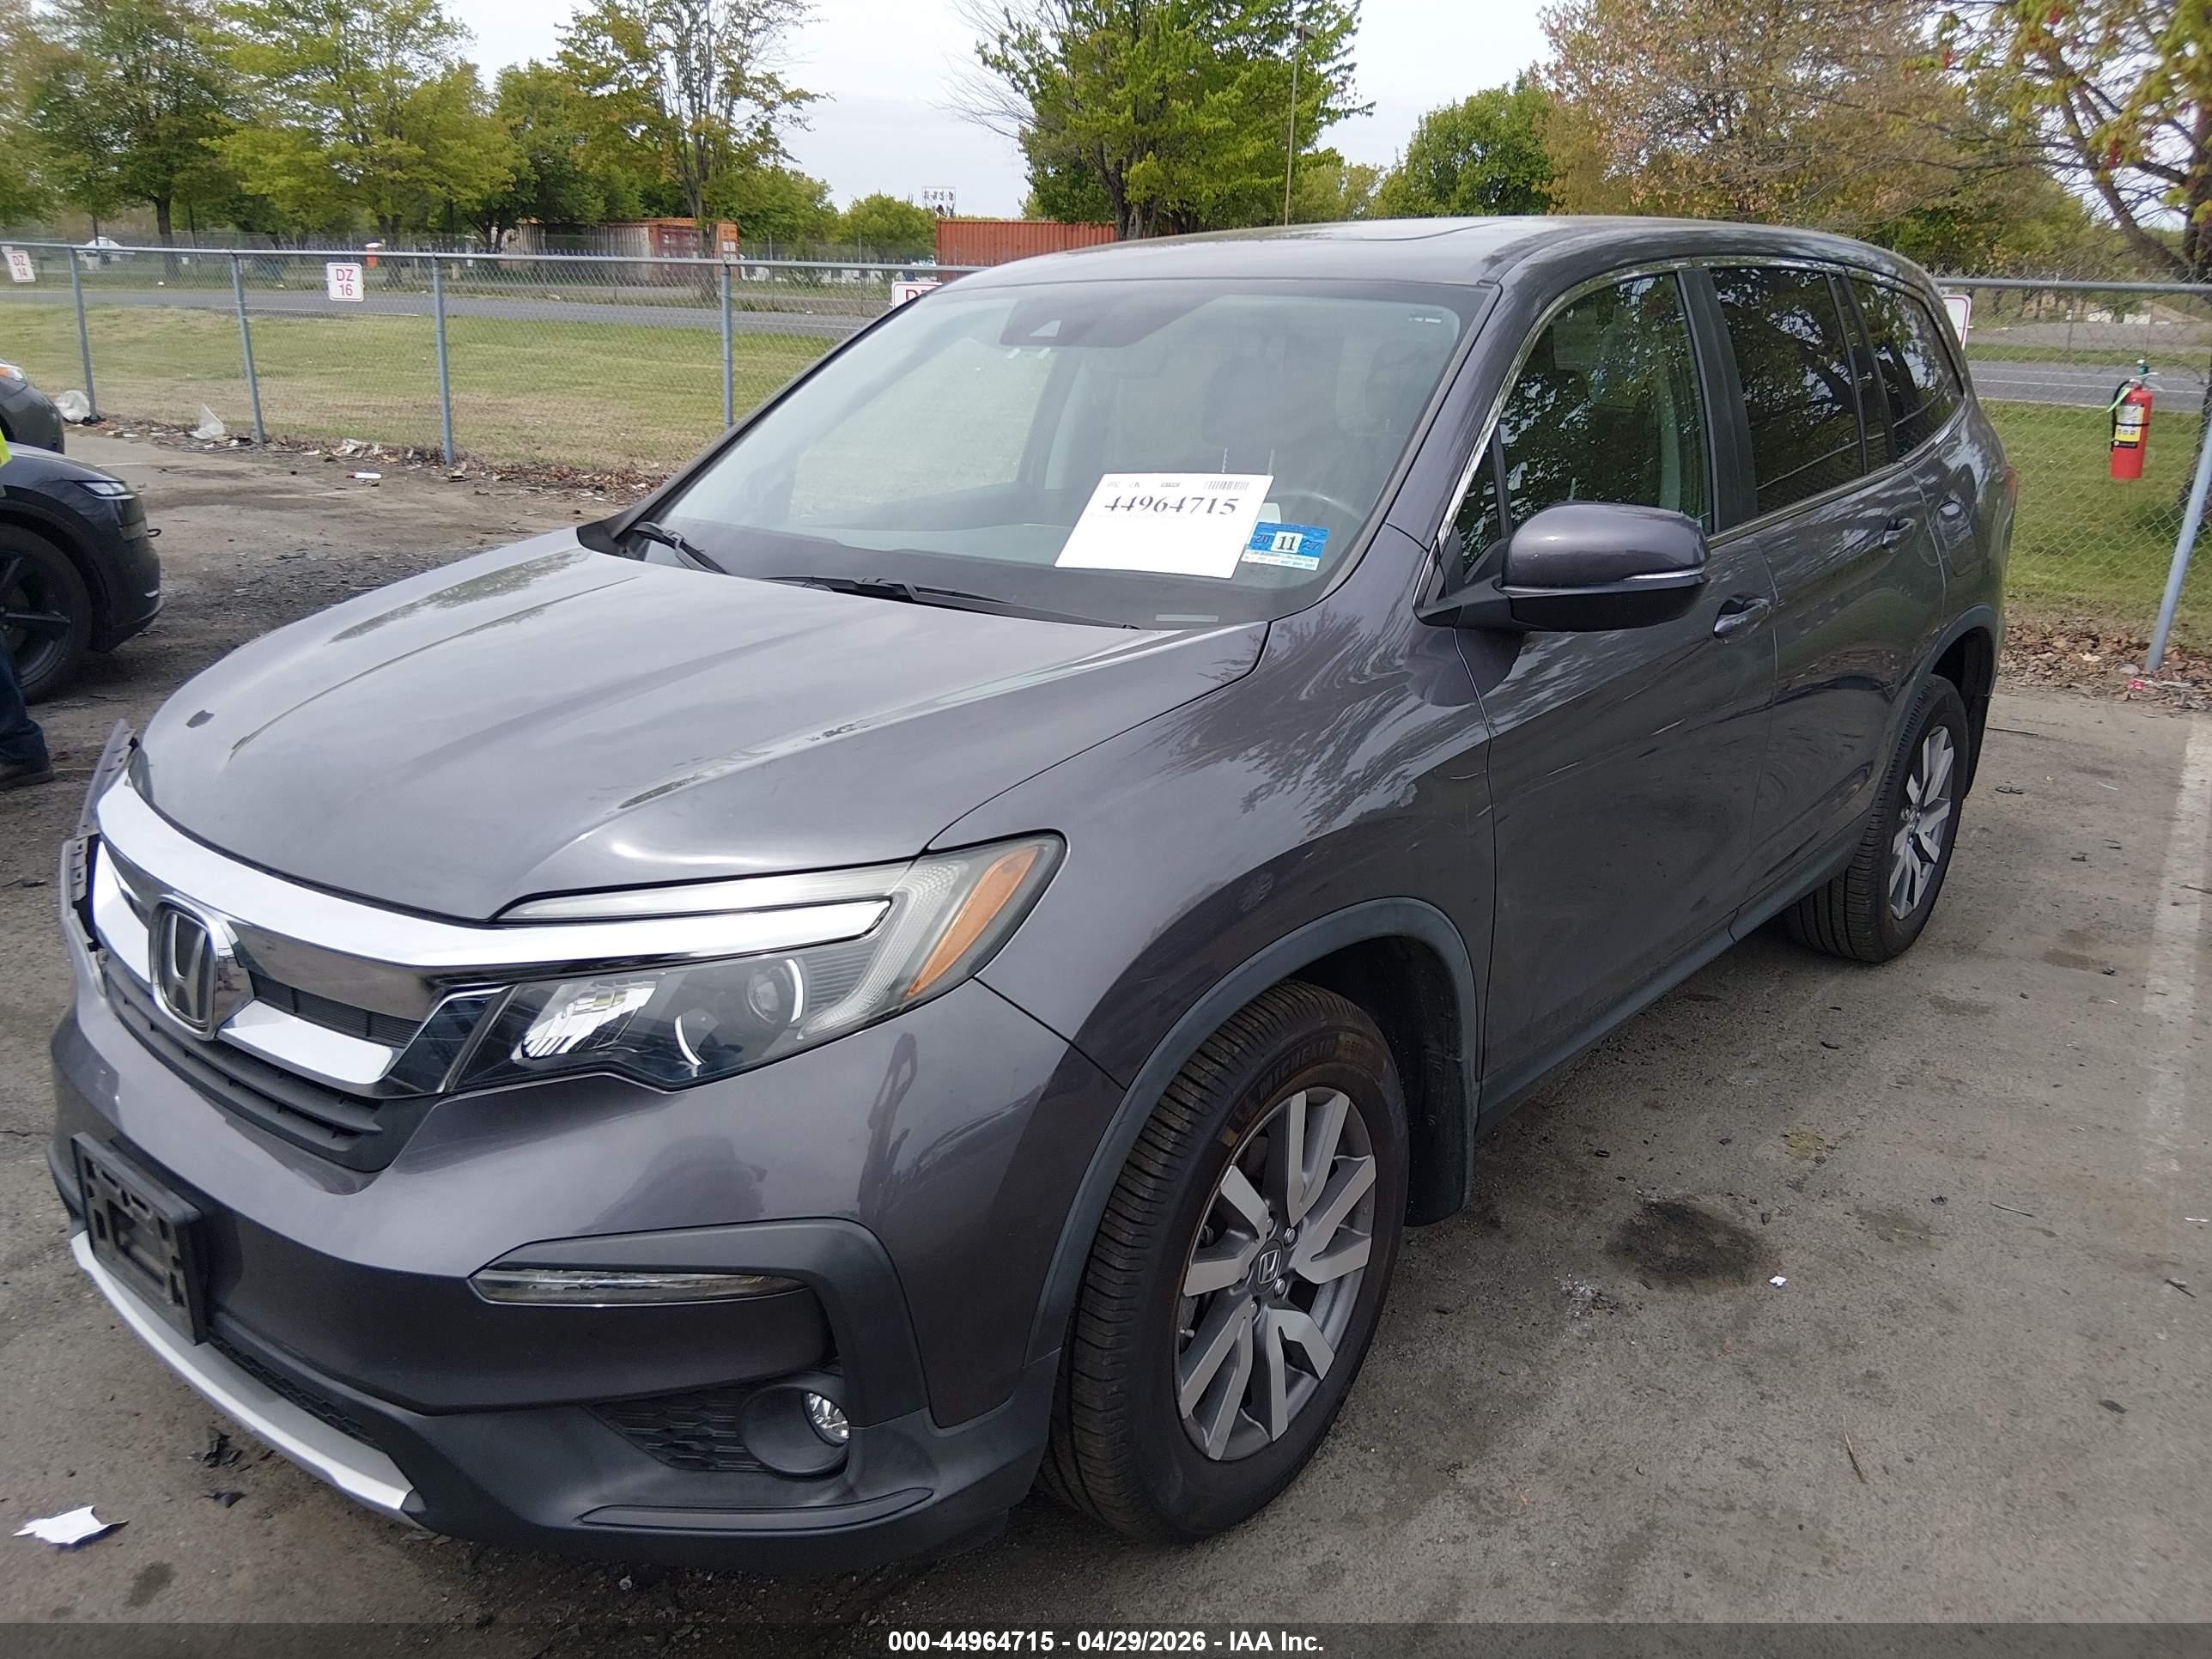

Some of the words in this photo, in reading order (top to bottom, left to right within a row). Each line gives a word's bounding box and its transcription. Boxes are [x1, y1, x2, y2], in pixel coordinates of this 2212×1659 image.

[336, 268, 355, 281] DZ
[338, 283, 353, 296] 16
[1104, 495, 1239, 515] 44964715
[1278, 535, 1297, 551] 11
